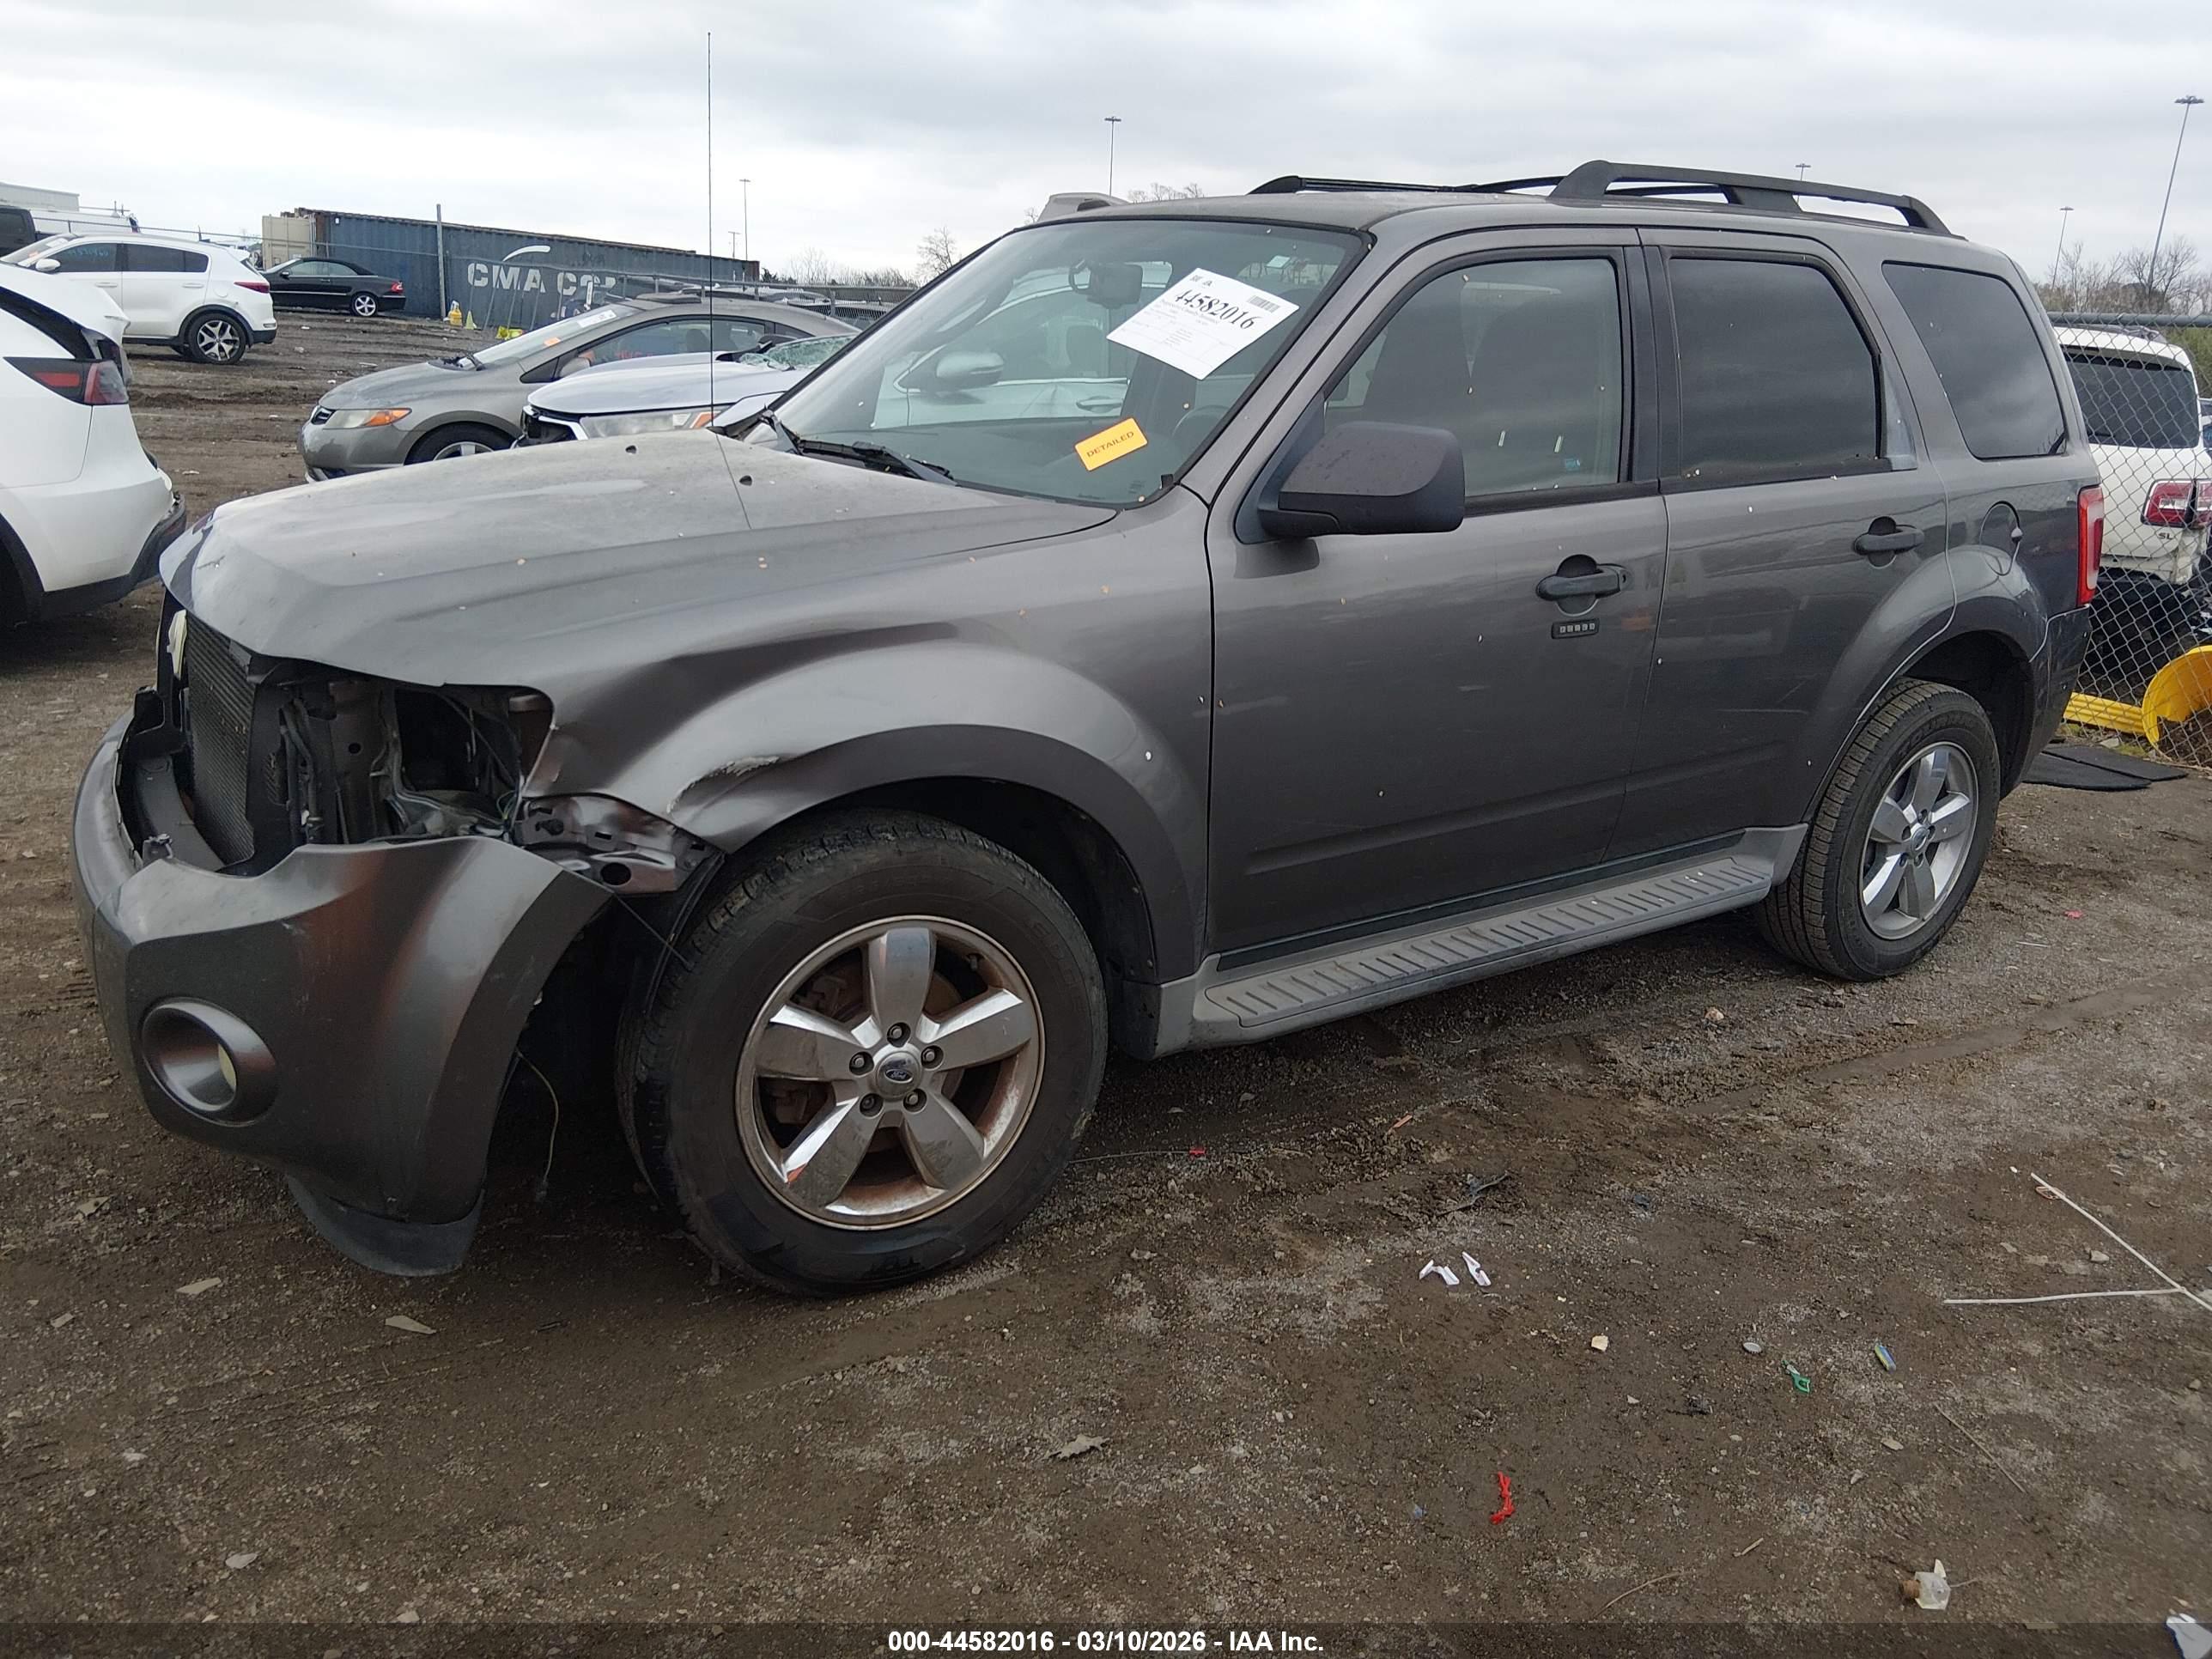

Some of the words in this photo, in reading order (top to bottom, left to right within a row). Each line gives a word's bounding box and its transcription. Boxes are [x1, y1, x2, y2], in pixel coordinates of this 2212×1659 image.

[467, 262, 546, 294] CMA
[1175, 289, 1263, 330] 44582016
[1086, 431, 1134, 458] DETAILED
[2158, 532, 2173, 540] SL
